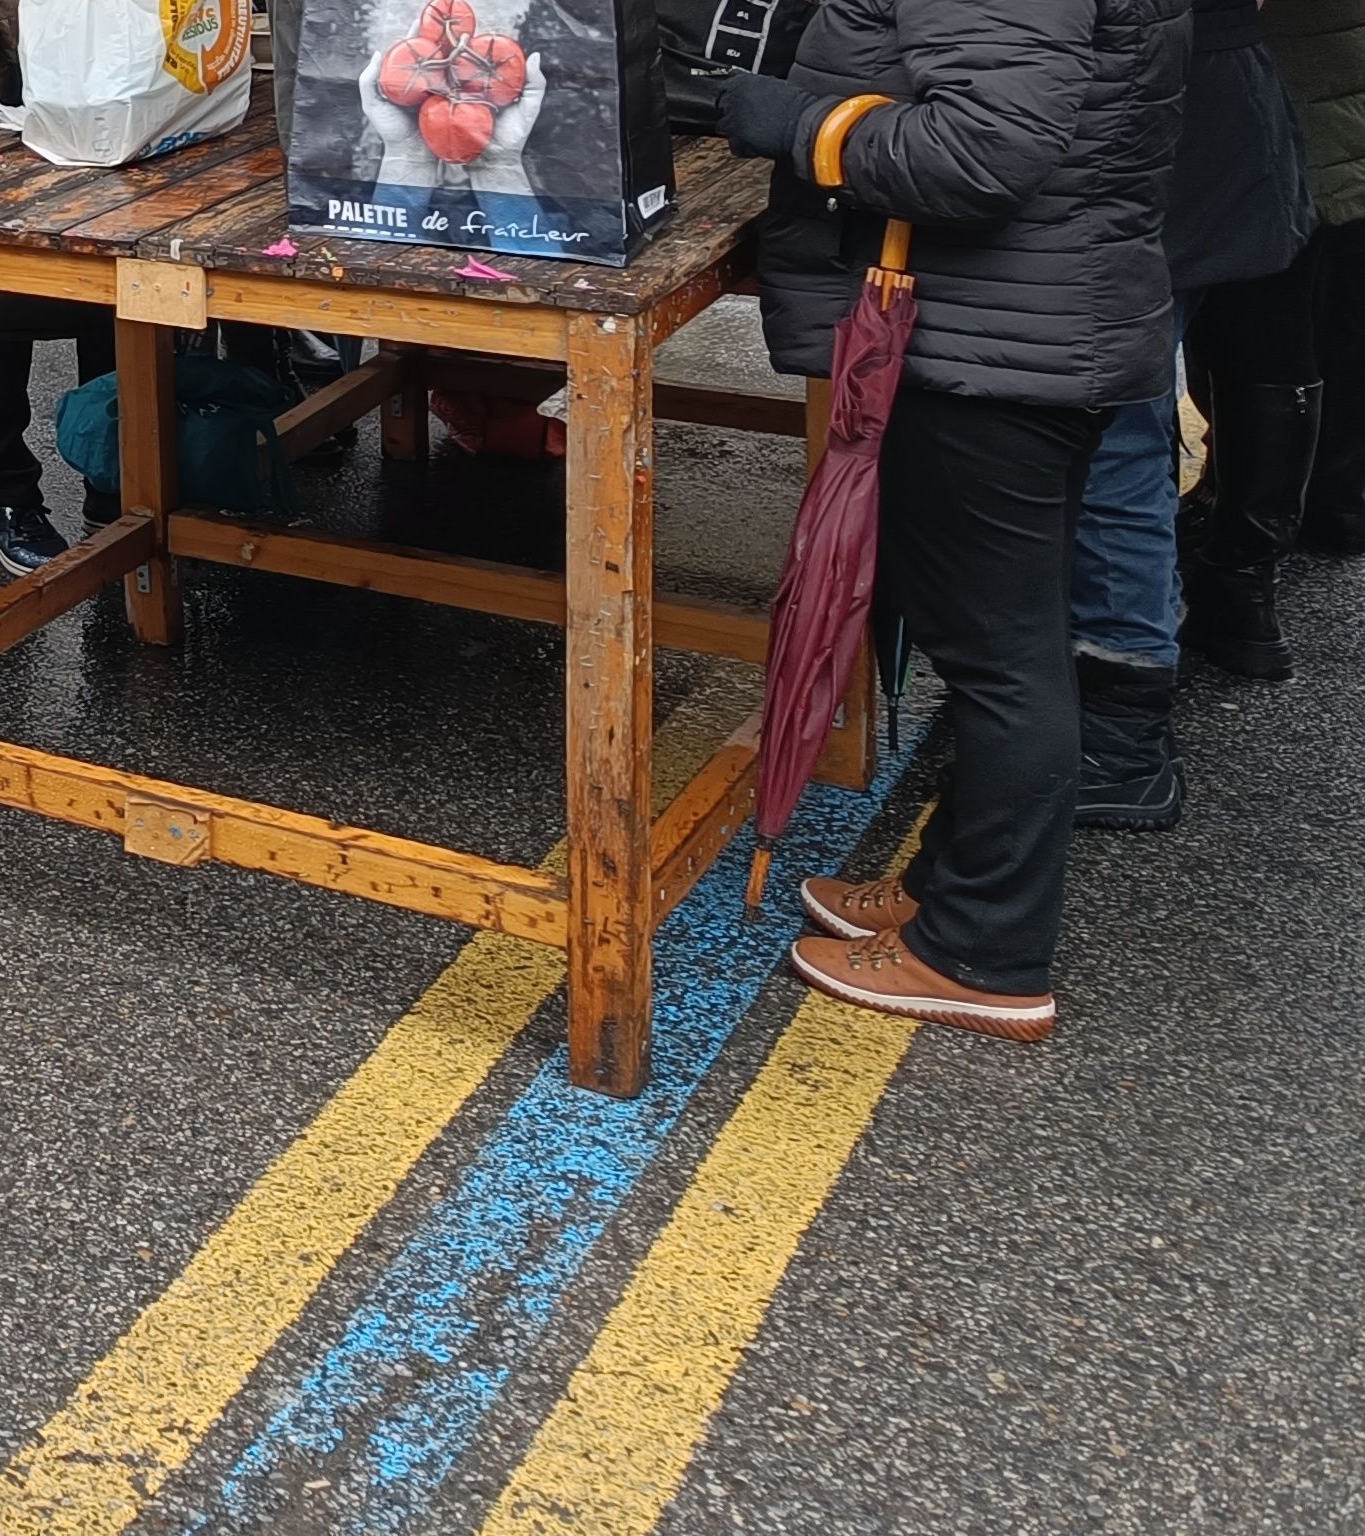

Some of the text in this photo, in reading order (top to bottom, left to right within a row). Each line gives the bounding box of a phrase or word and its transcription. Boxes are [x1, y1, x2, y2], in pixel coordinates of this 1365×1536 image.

[328, 199, 590, 242] PALETTE de fraîcheur
